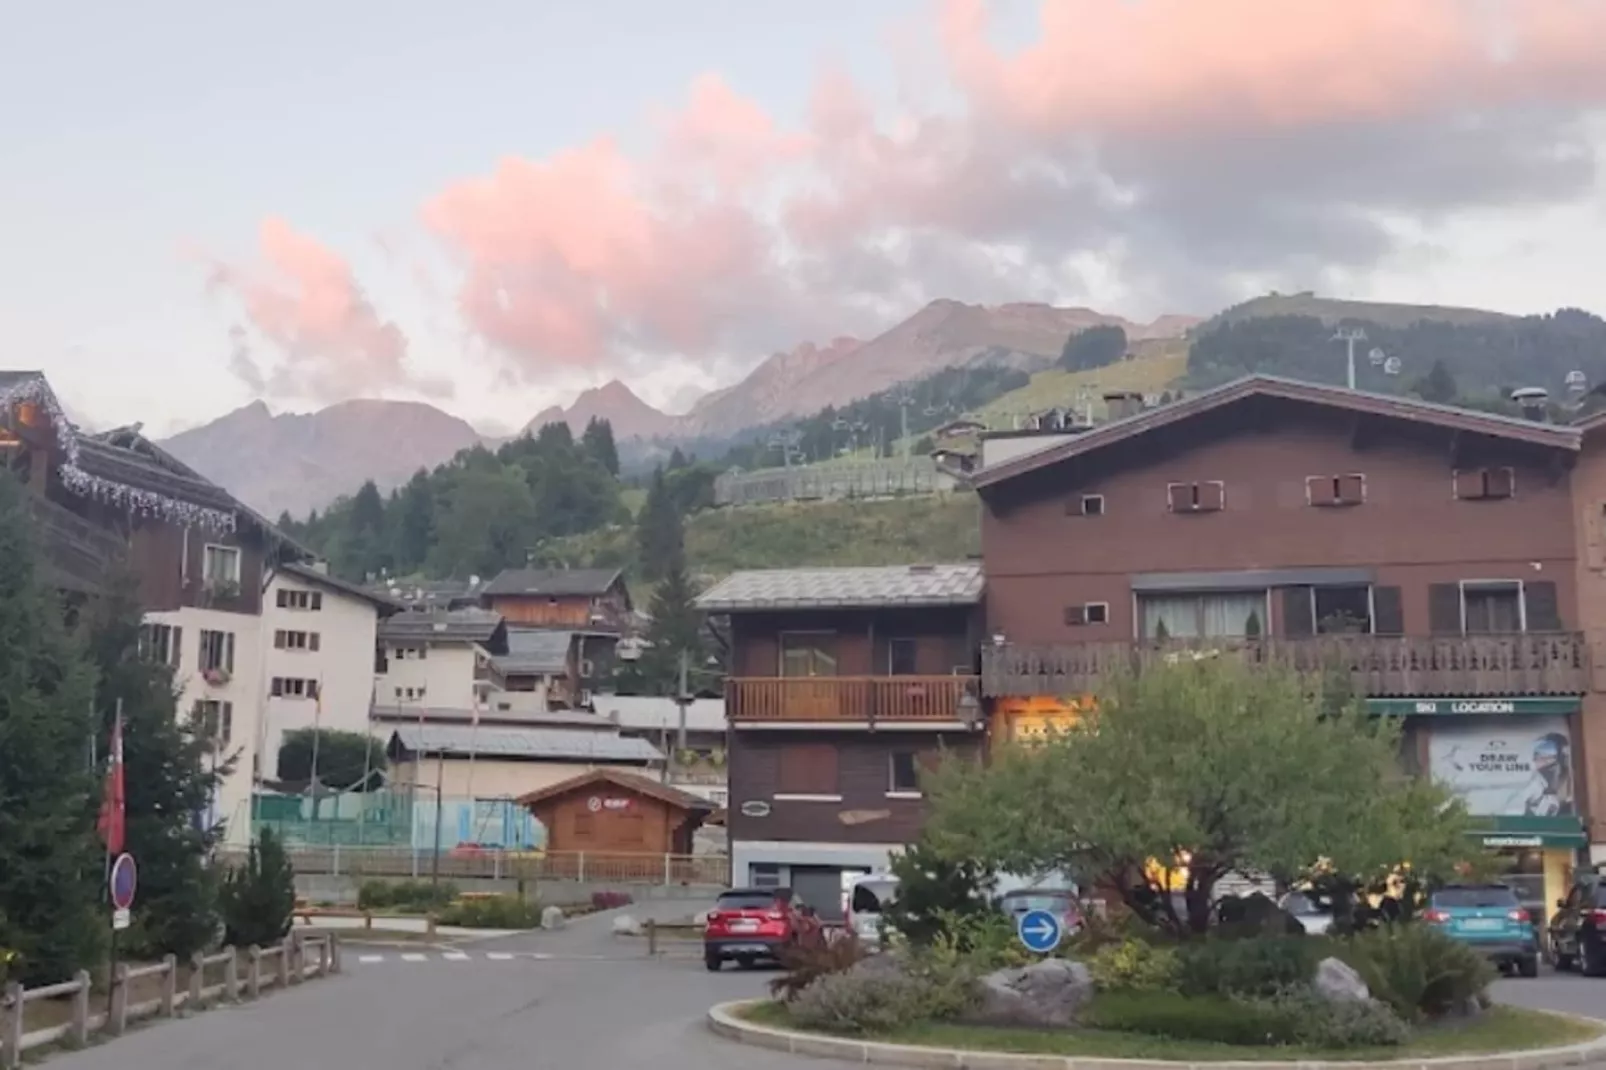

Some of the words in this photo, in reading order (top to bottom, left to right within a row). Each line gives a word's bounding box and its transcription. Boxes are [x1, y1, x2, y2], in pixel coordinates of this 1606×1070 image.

[1416, 702, 1436, 713] SKI
[1451, 702, 1514, 713] LOCATION
[1480, 753, 1518, 762] DRAW
[1469, 763, 1502, 772] YOUR
[1505, 763, 1530, 772] LINE
